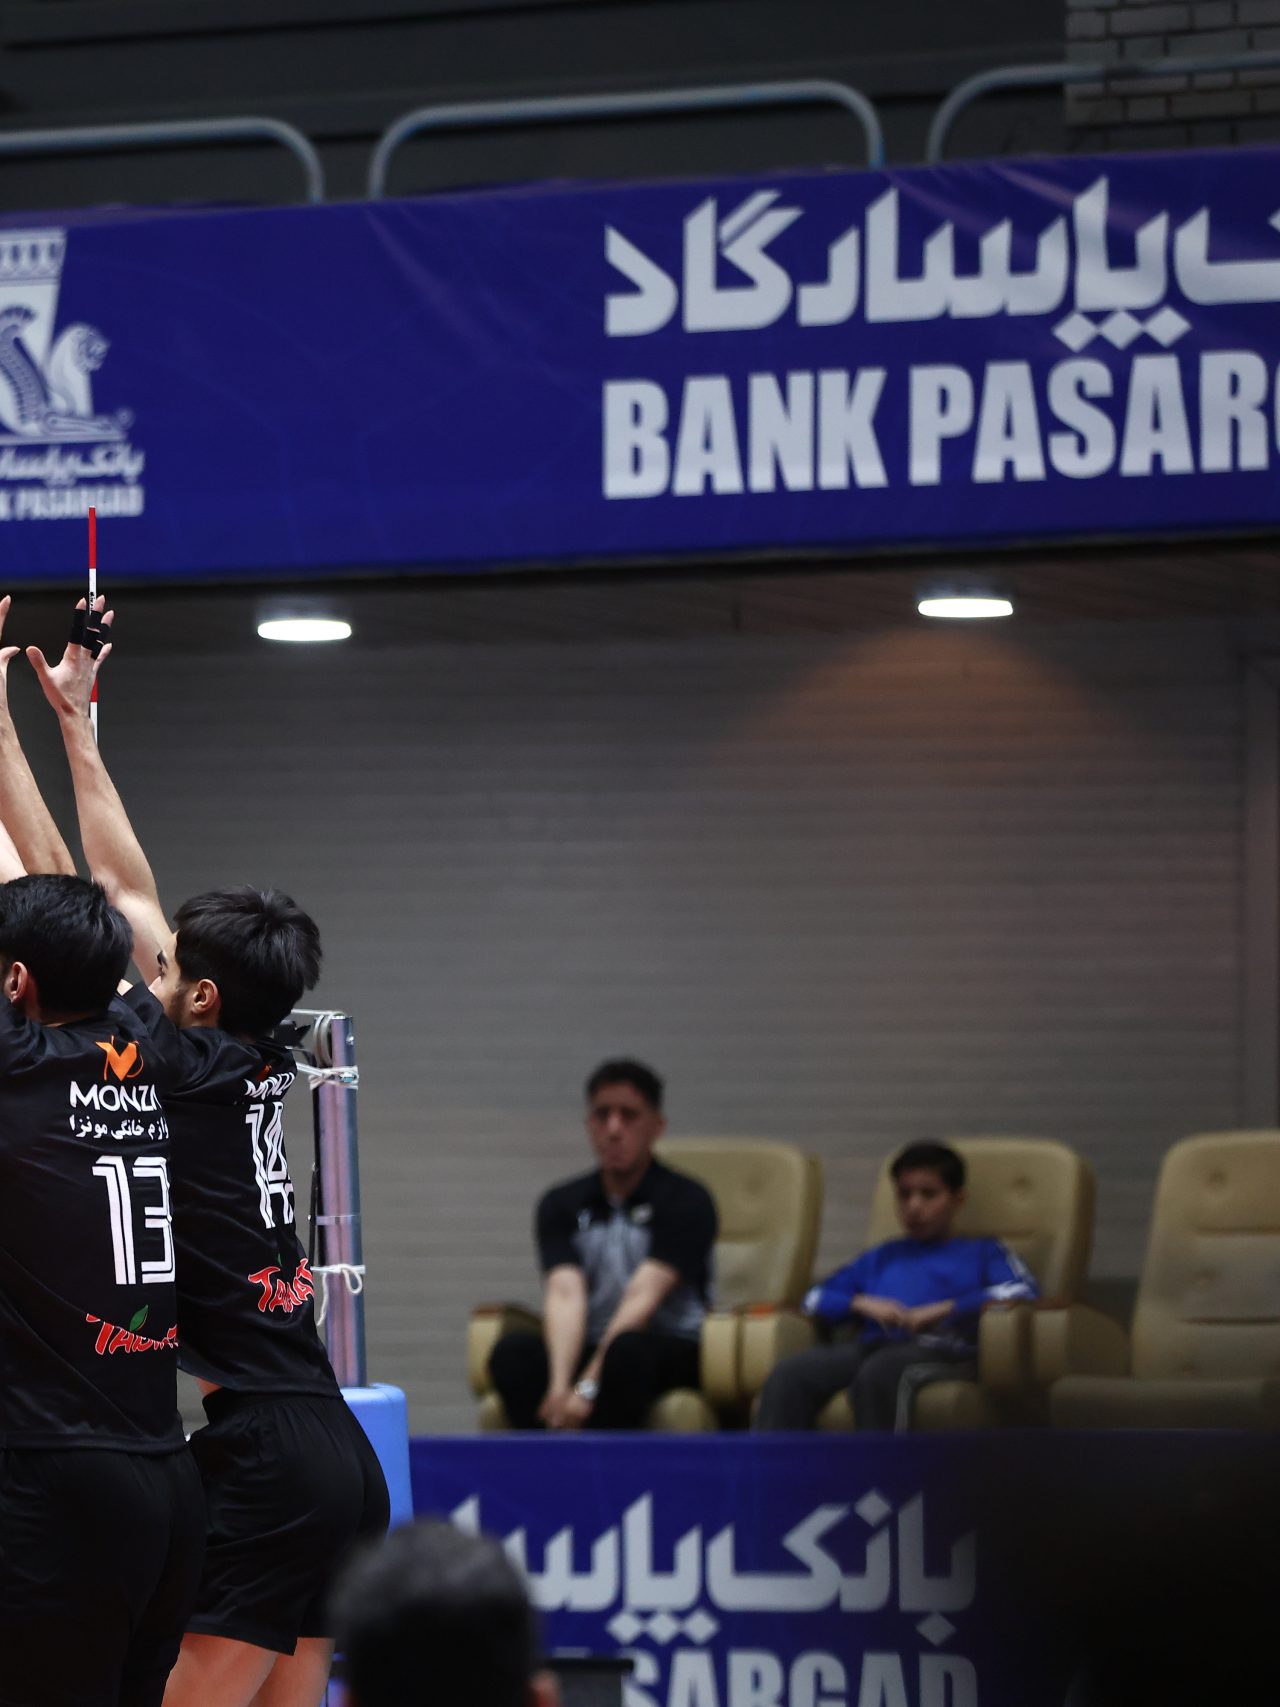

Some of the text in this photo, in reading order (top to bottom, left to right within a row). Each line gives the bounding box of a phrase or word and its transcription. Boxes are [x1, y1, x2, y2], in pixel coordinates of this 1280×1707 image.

[604, 175, 1192, 353] پاسارگاد
[602, 350, 1280, 499] BANK PASAR
[69, 1080, 163, 1113] MONZA
[69, 1113, 108, 1139] مونزا
[110, 1119, 145, 1140] خانگی
[91, 1155, 175, 1286] 13
[245, 1101, 295, 1230] 14
